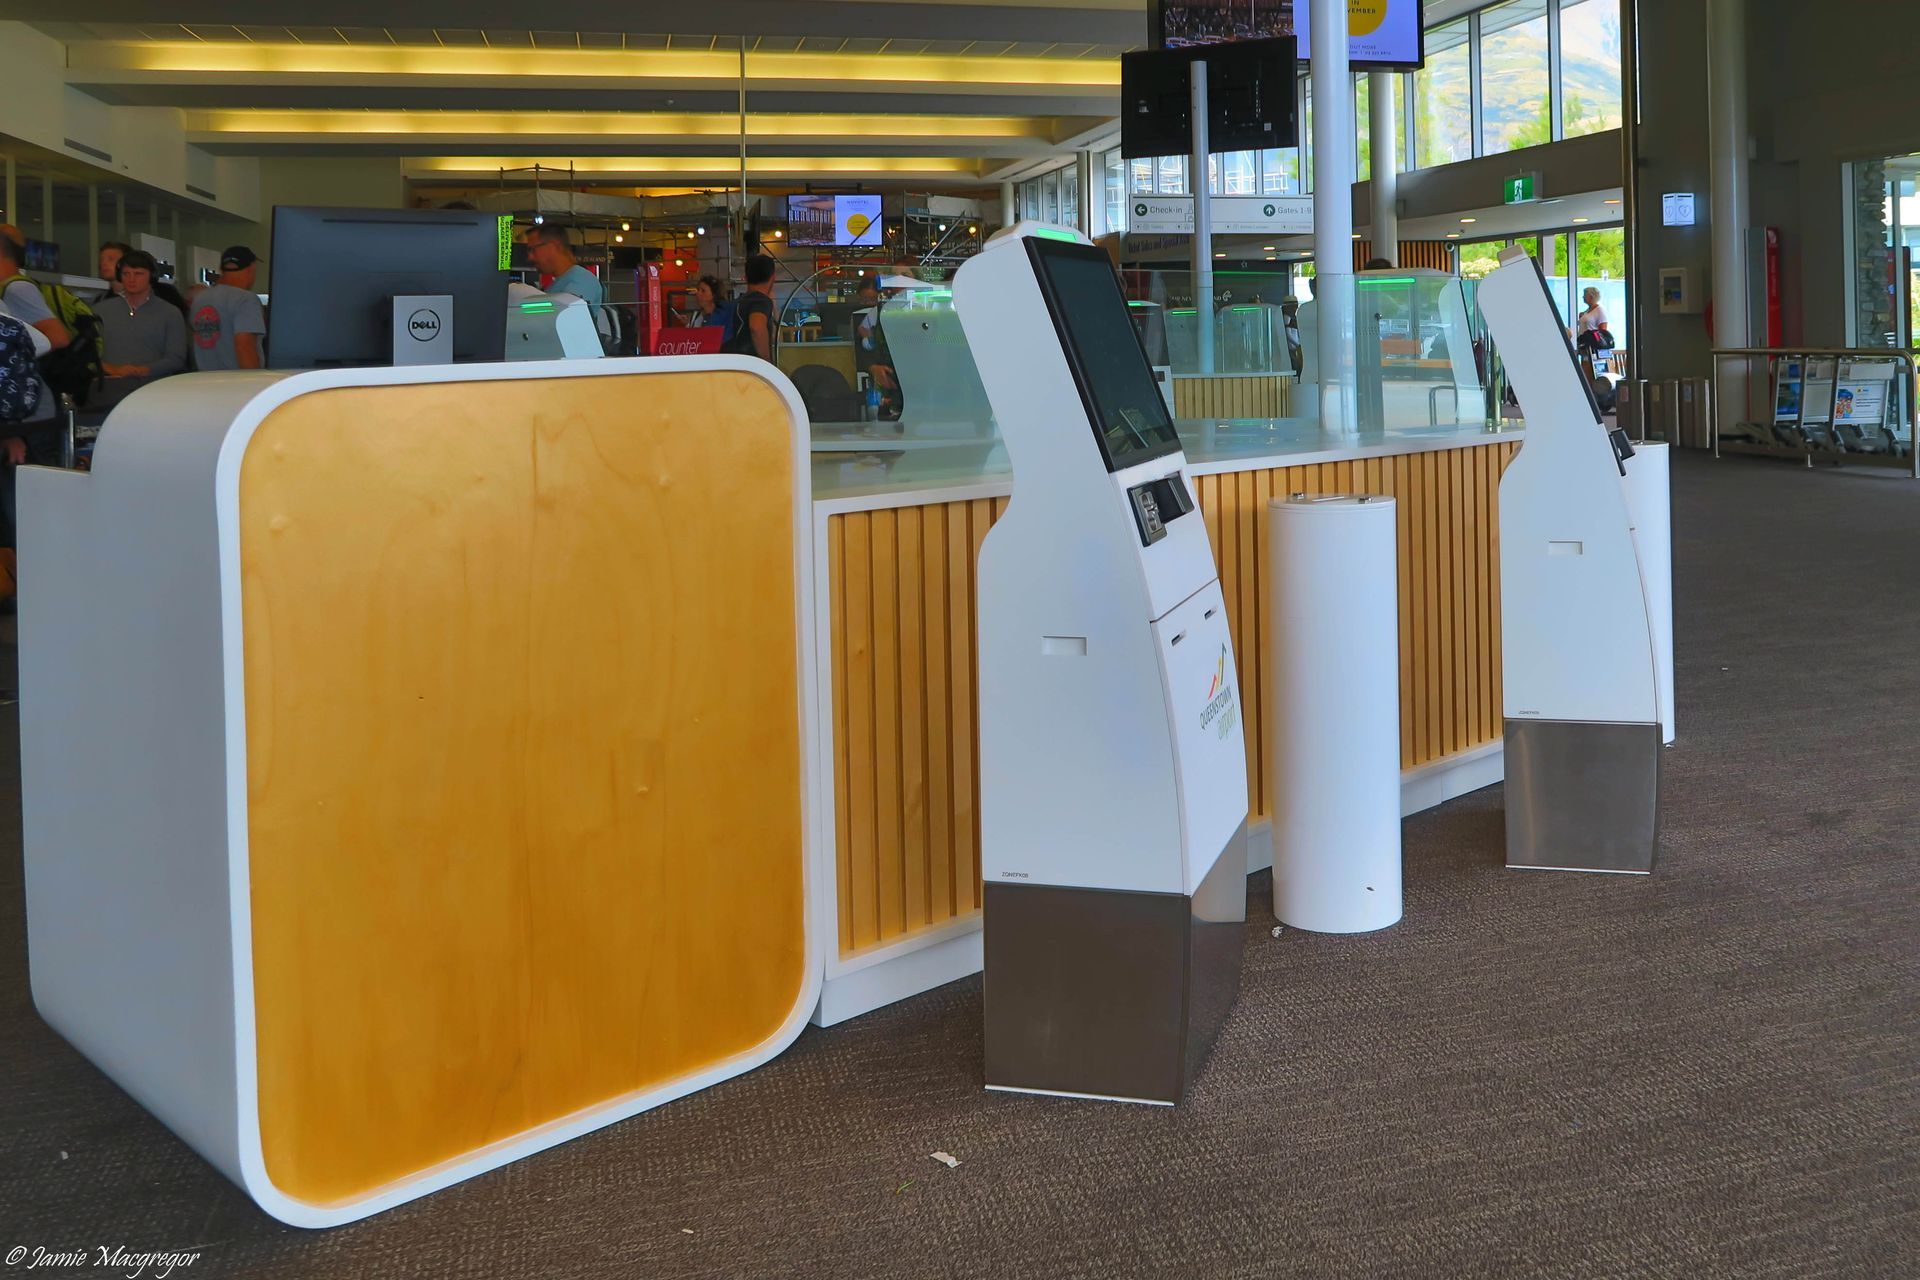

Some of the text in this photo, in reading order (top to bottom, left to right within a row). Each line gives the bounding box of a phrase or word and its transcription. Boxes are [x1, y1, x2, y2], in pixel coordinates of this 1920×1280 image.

[1149, 205, 1183, 214] Check-in
[1277, 206, 1299, 214] Gates
[412, 320, 437, 329] DELL
[658, 340, 701, 355] counter
[1199, 685, 1232, 730] QUEENSTOWN
